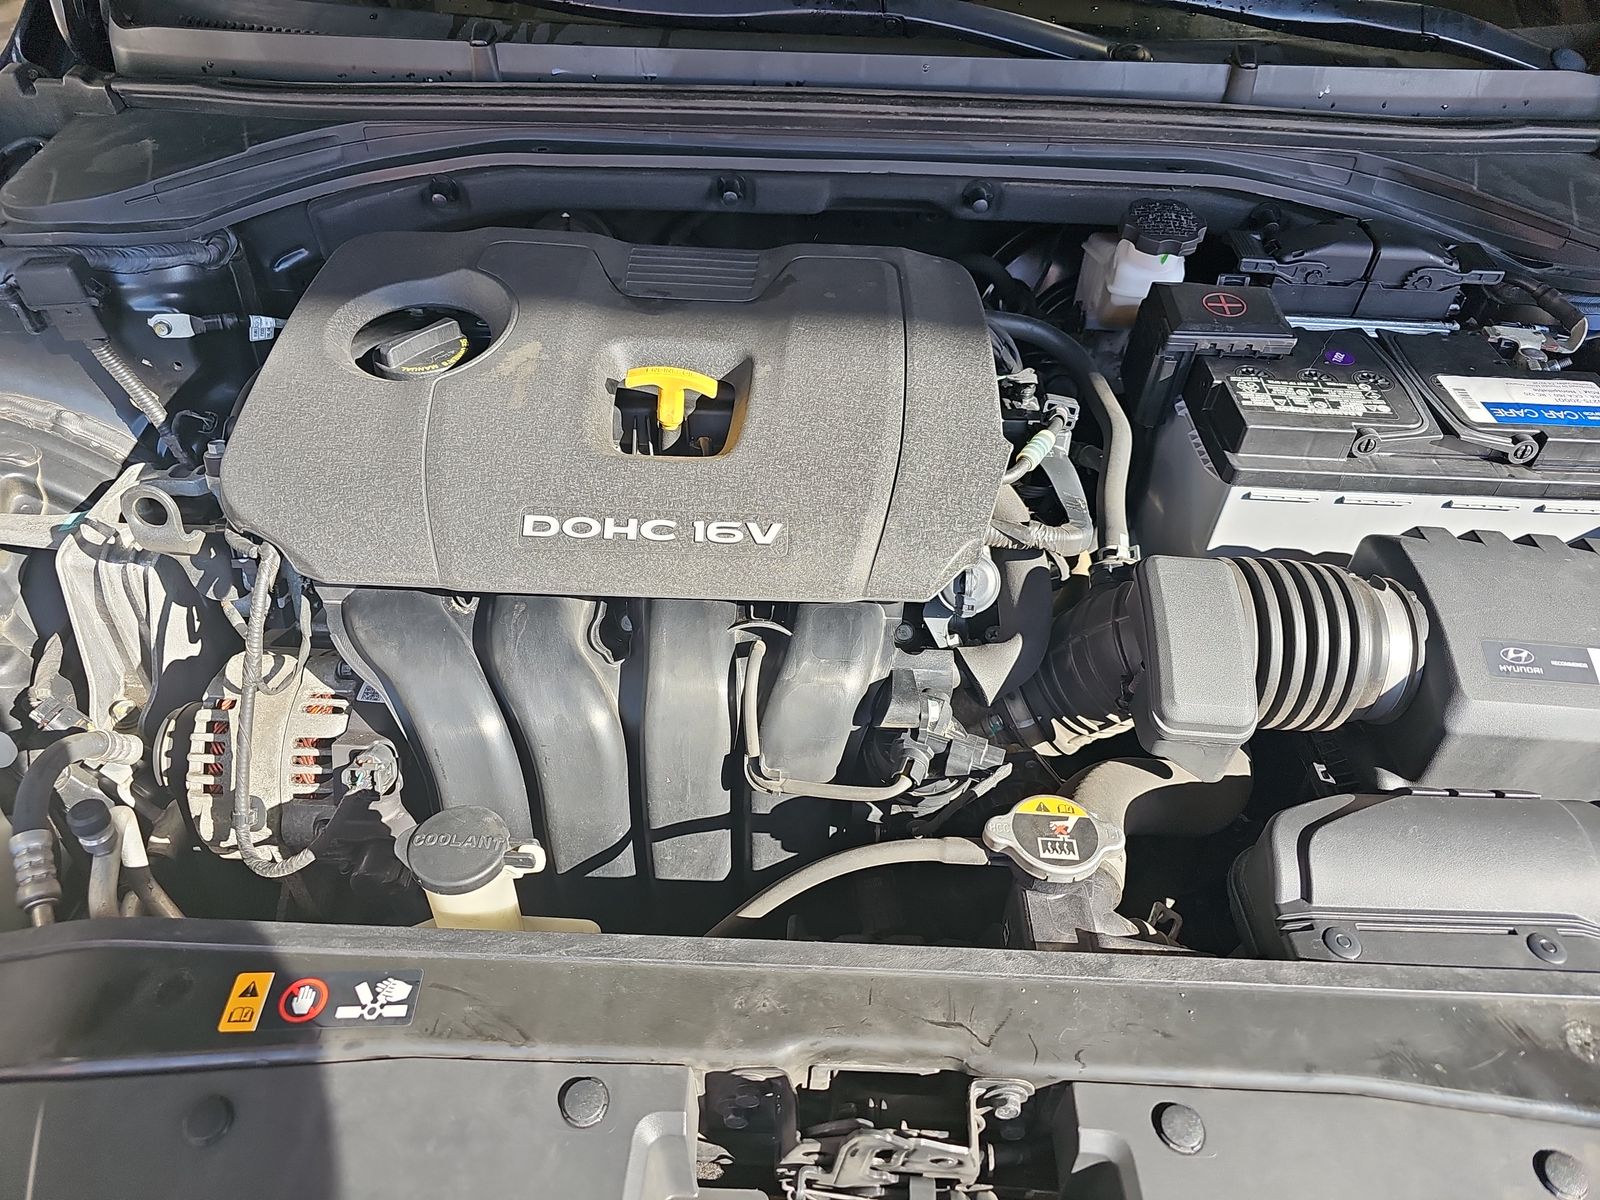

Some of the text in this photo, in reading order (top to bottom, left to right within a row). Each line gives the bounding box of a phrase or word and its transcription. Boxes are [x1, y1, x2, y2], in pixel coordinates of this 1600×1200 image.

[1490, 407, 1539, 418] CARE
[1540, 409, 1580, 420] CAR
[522, 514, 783, 546] DOHC 16V
[1498, 664, 1544, 675] HYUNDAI
[413, 832, 505, 851] COOLANT
